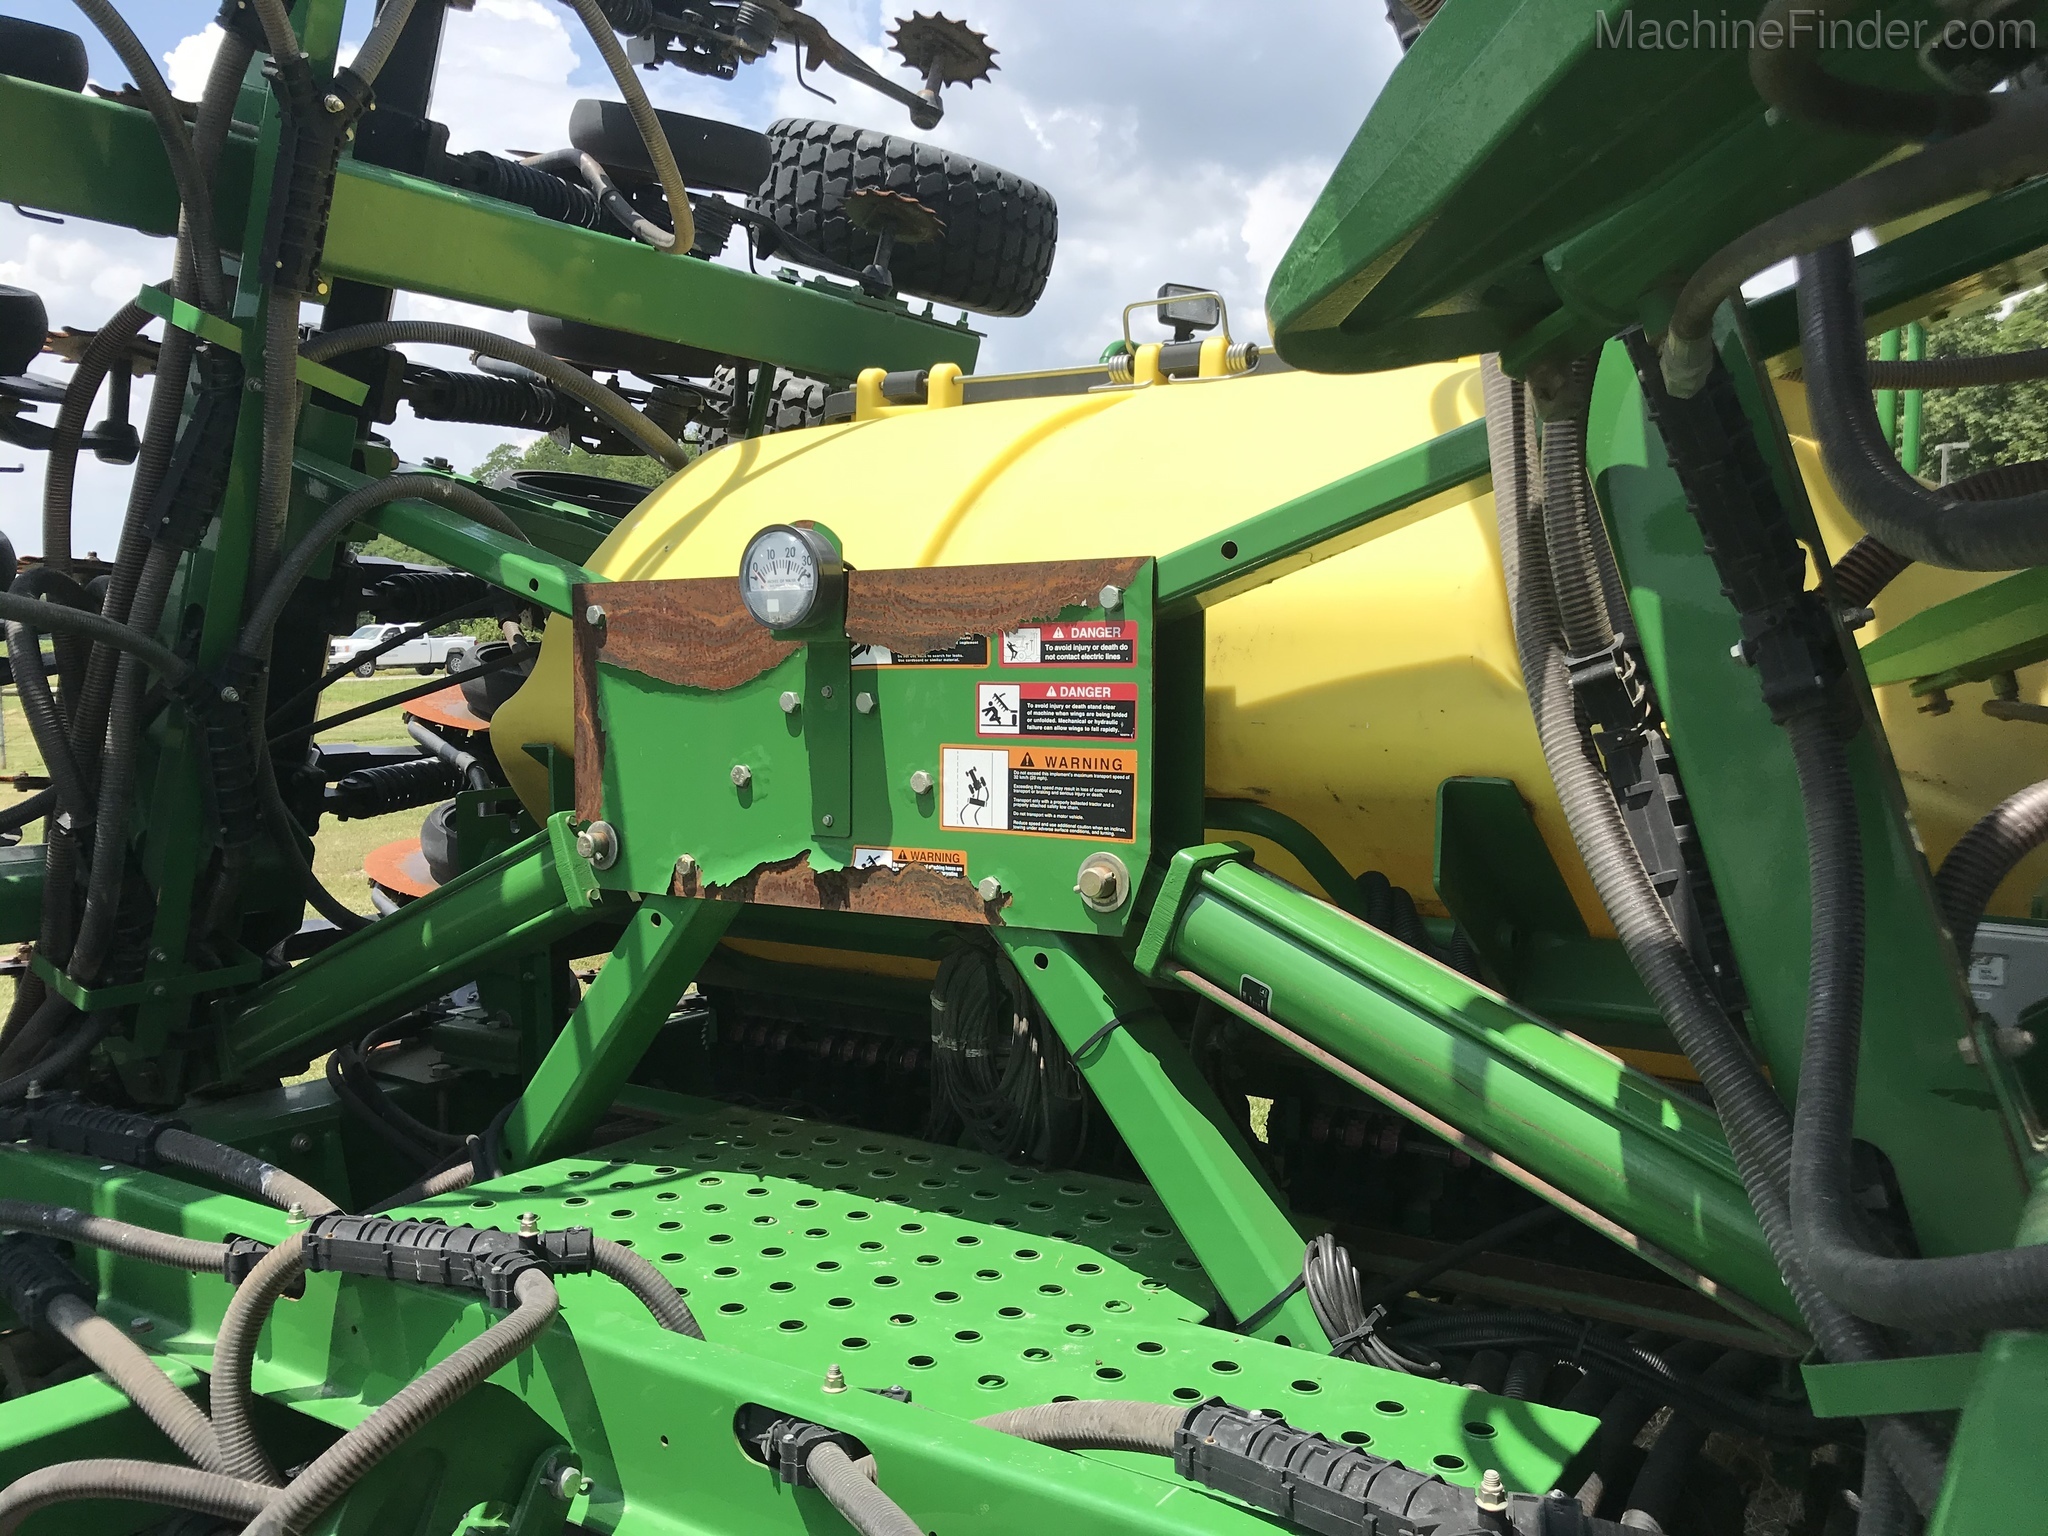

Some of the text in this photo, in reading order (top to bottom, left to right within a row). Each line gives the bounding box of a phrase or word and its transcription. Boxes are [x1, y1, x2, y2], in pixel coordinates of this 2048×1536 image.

[752, 547, 812, 573] 0 10 20 30
[1071, 627, 1121, 638] DANGER
[1073, 644, 1091, 652] injury
[1100, 643, 1119, 651] death
[1119, 643, 1129, 651] do
[1060, 686, 1111, 698] DANGER
[1045, 756, 1123, 771] WARNING
[910, 850, 960, 863] WARNING
